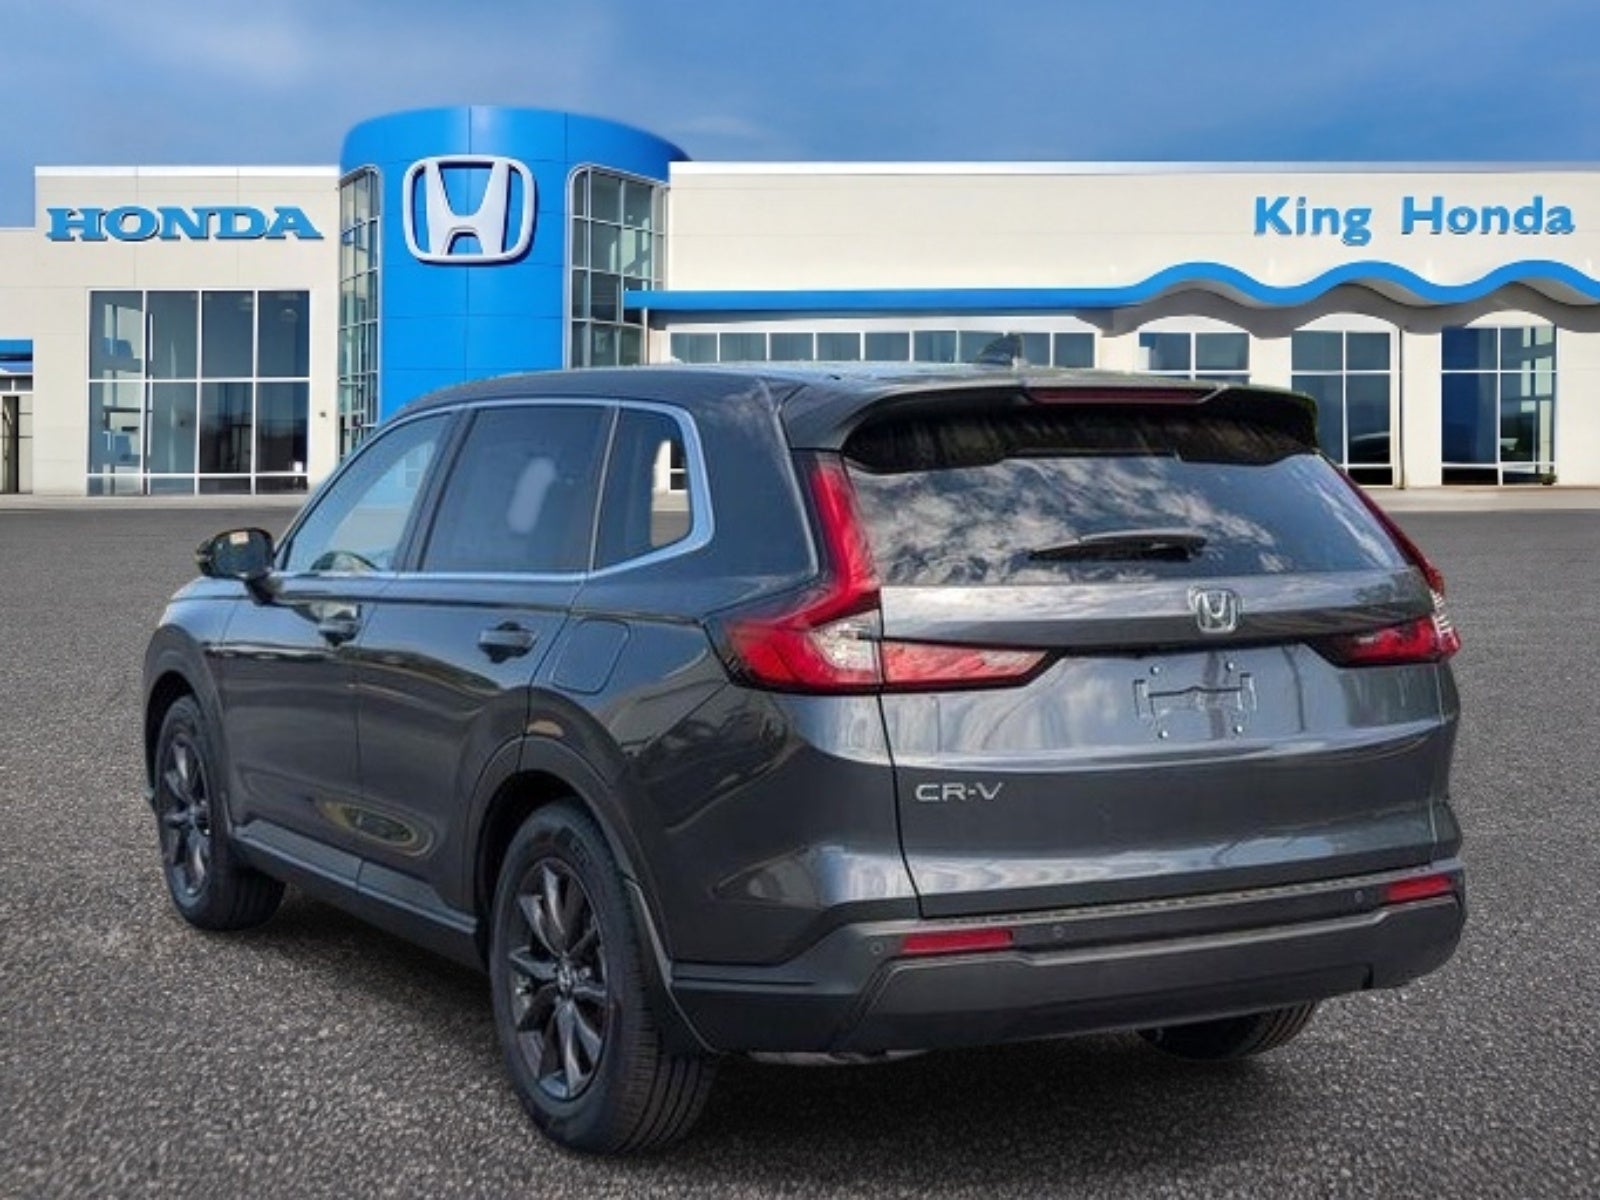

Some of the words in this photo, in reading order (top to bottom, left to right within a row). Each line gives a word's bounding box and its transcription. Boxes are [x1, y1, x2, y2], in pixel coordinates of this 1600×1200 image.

[46, 206, 324, 241] HONDA
[1255, 196, 1372, 246] King
[1401, 195, 1576, 235] Honda
[915, 782, 1004, 802] CR-V
